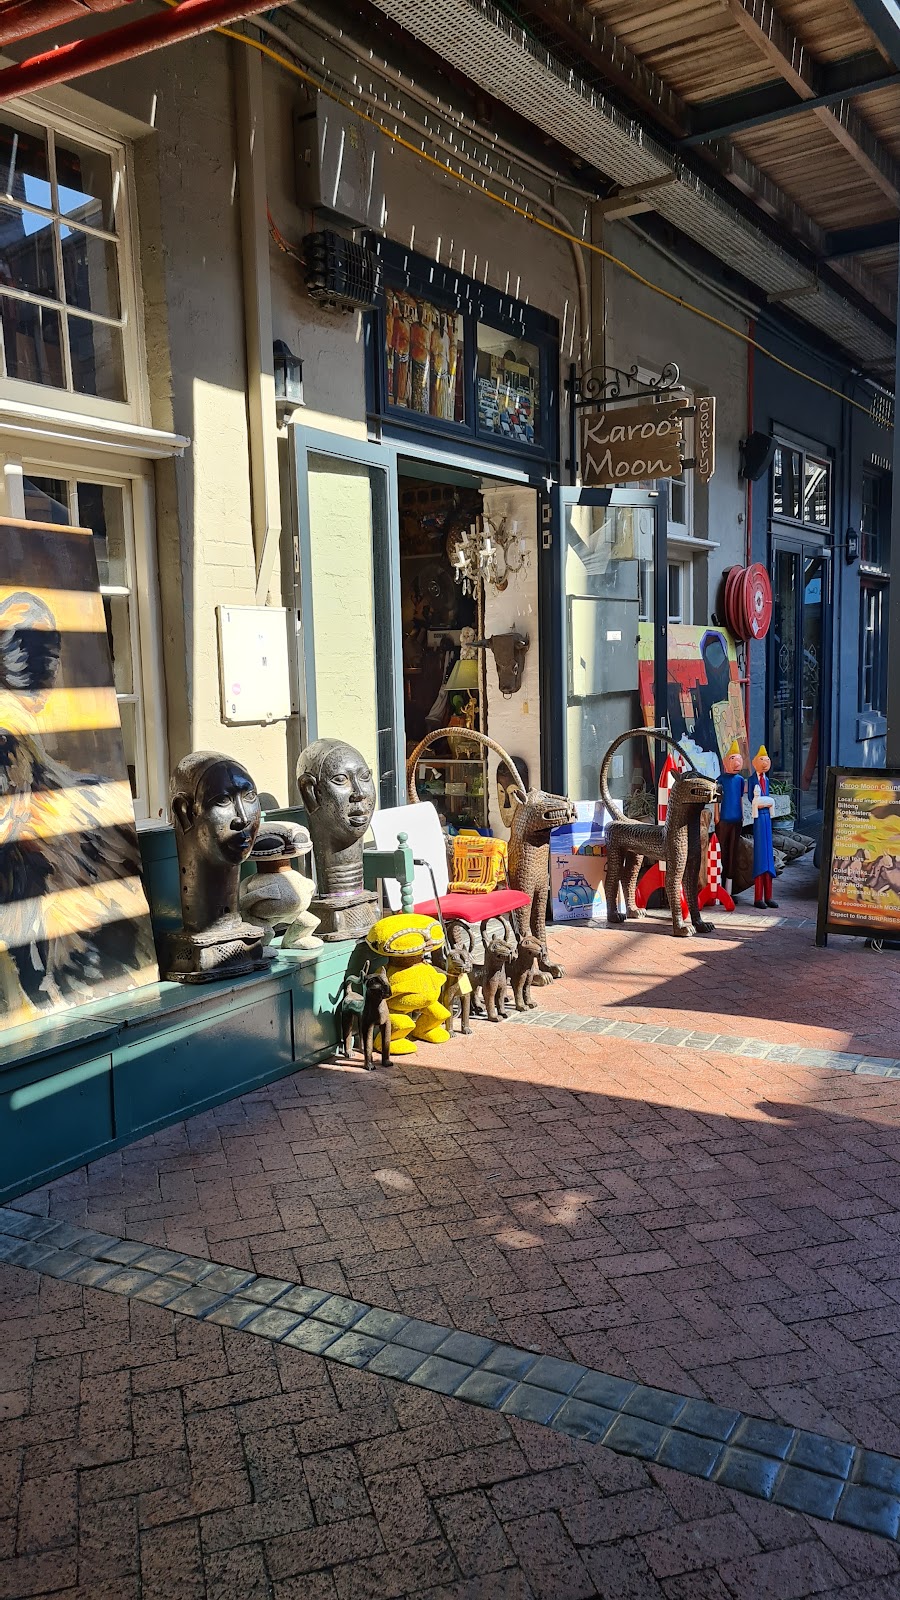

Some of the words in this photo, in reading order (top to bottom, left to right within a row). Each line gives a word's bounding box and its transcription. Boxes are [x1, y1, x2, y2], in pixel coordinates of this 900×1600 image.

[584, 415, 672, 449] Karoo
[700, 401, 710, 474] Country
[584, 449, 672, 481] Moon
